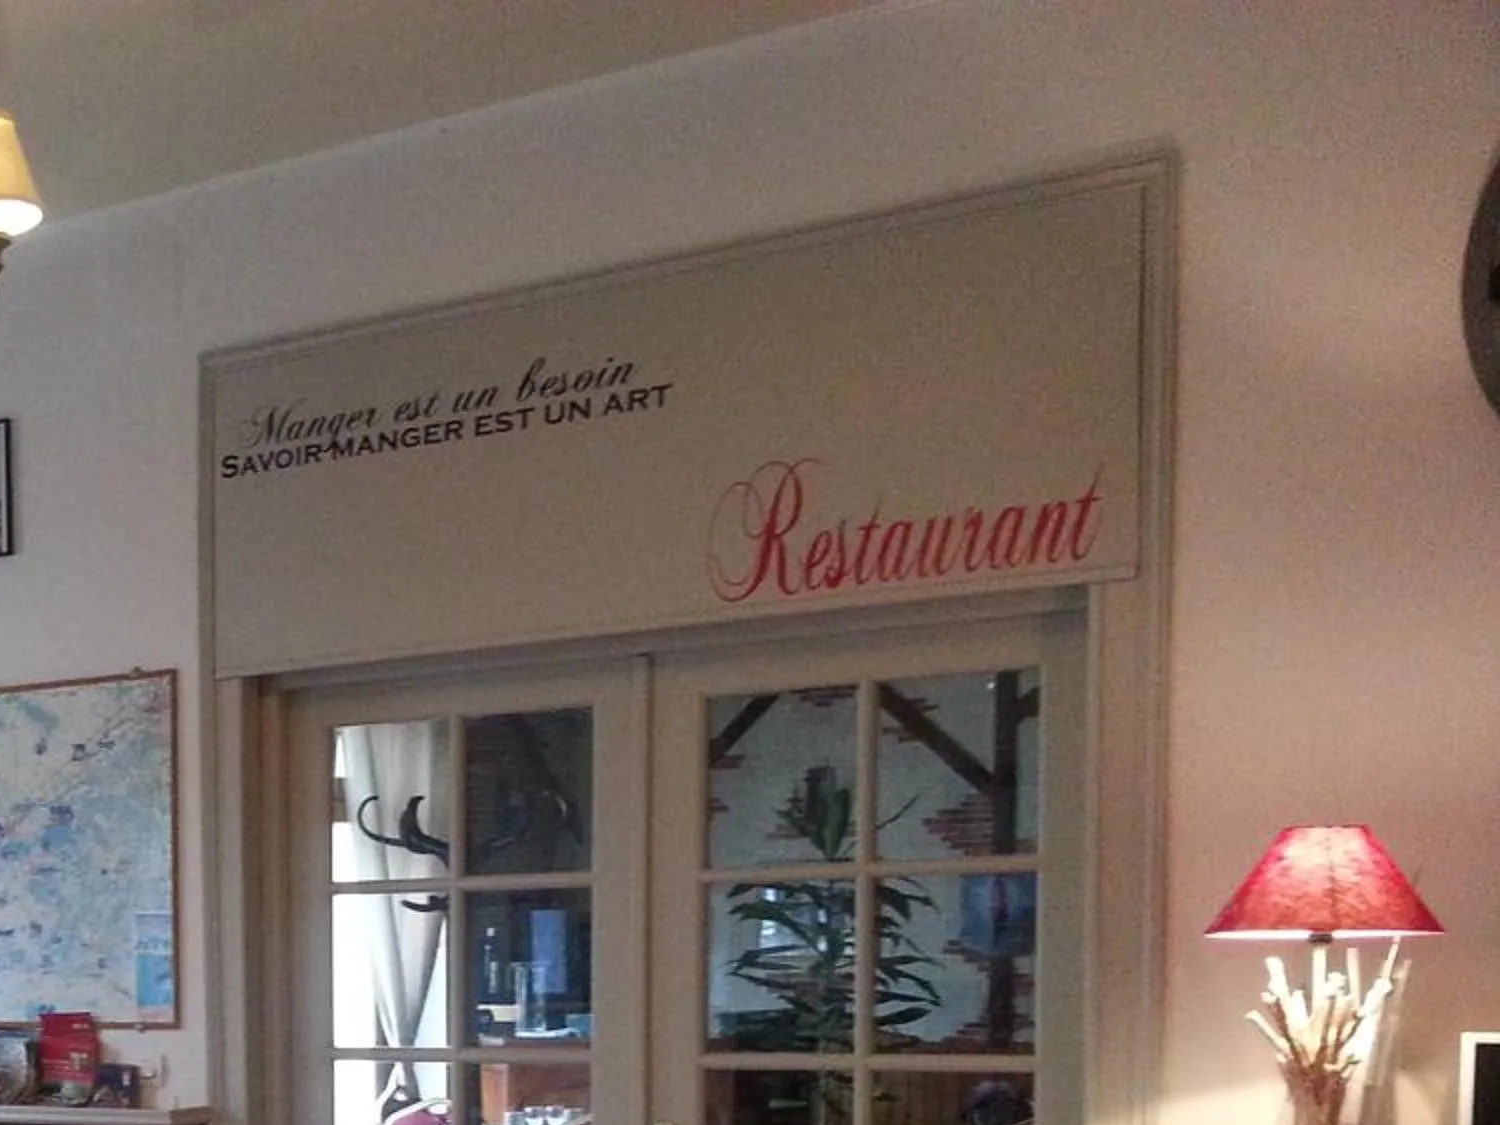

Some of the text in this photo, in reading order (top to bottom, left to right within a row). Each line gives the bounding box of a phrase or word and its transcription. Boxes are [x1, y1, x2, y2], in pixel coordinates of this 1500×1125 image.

[220, 384, 675, 480] SAVOIR MANGER EST UN ART
[242, 356, 638, 452] Manger est un besoin
[706, 458, 1103, 602] Restaurant
